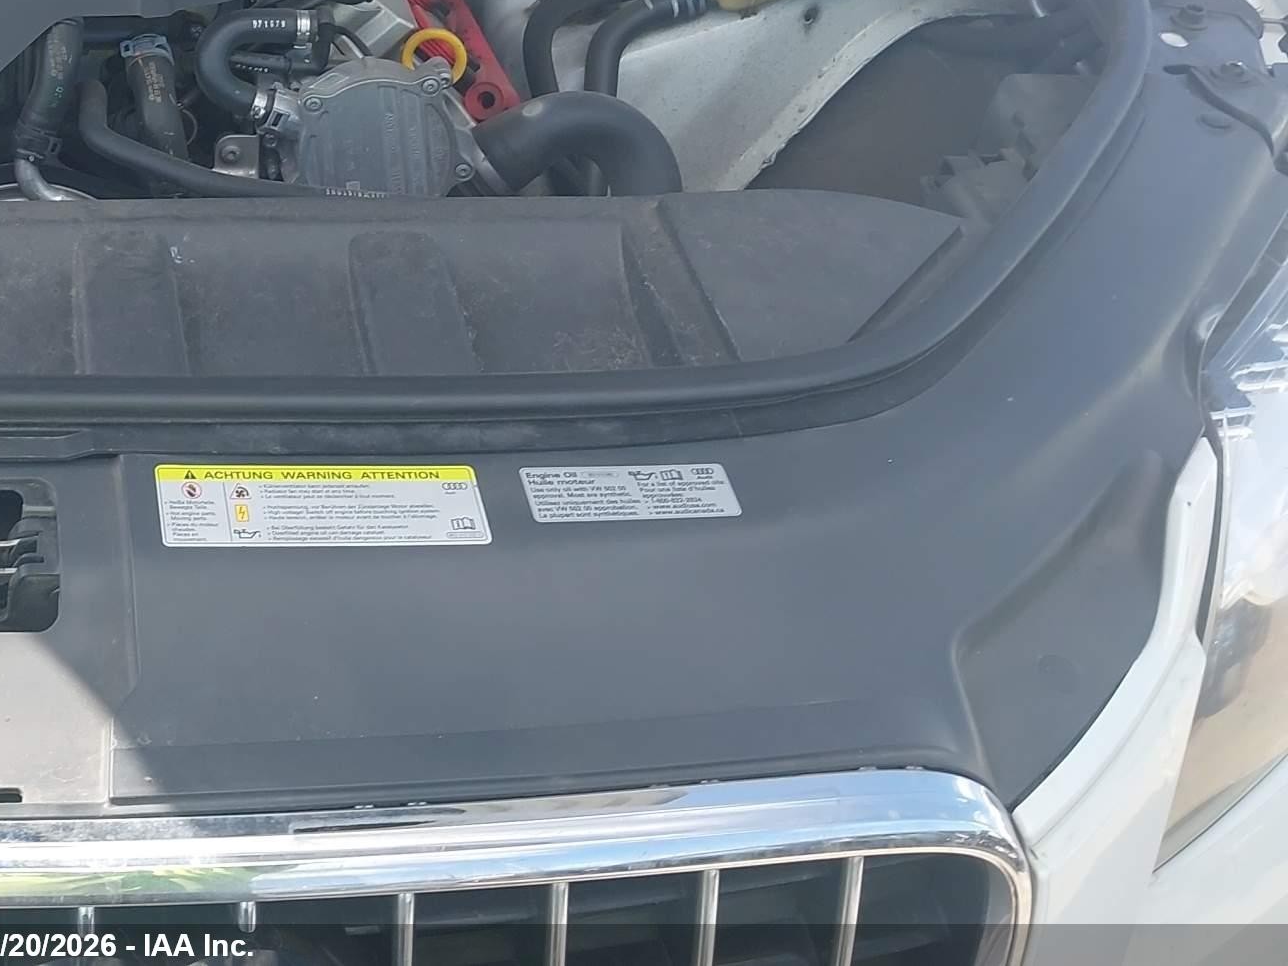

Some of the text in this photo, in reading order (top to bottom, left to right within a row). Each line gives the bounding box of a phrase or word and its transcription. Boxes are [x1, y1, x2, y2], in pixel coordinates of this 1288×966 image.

[204, 470, 440, 480] ACHTUNG WARNING ATTENTION
